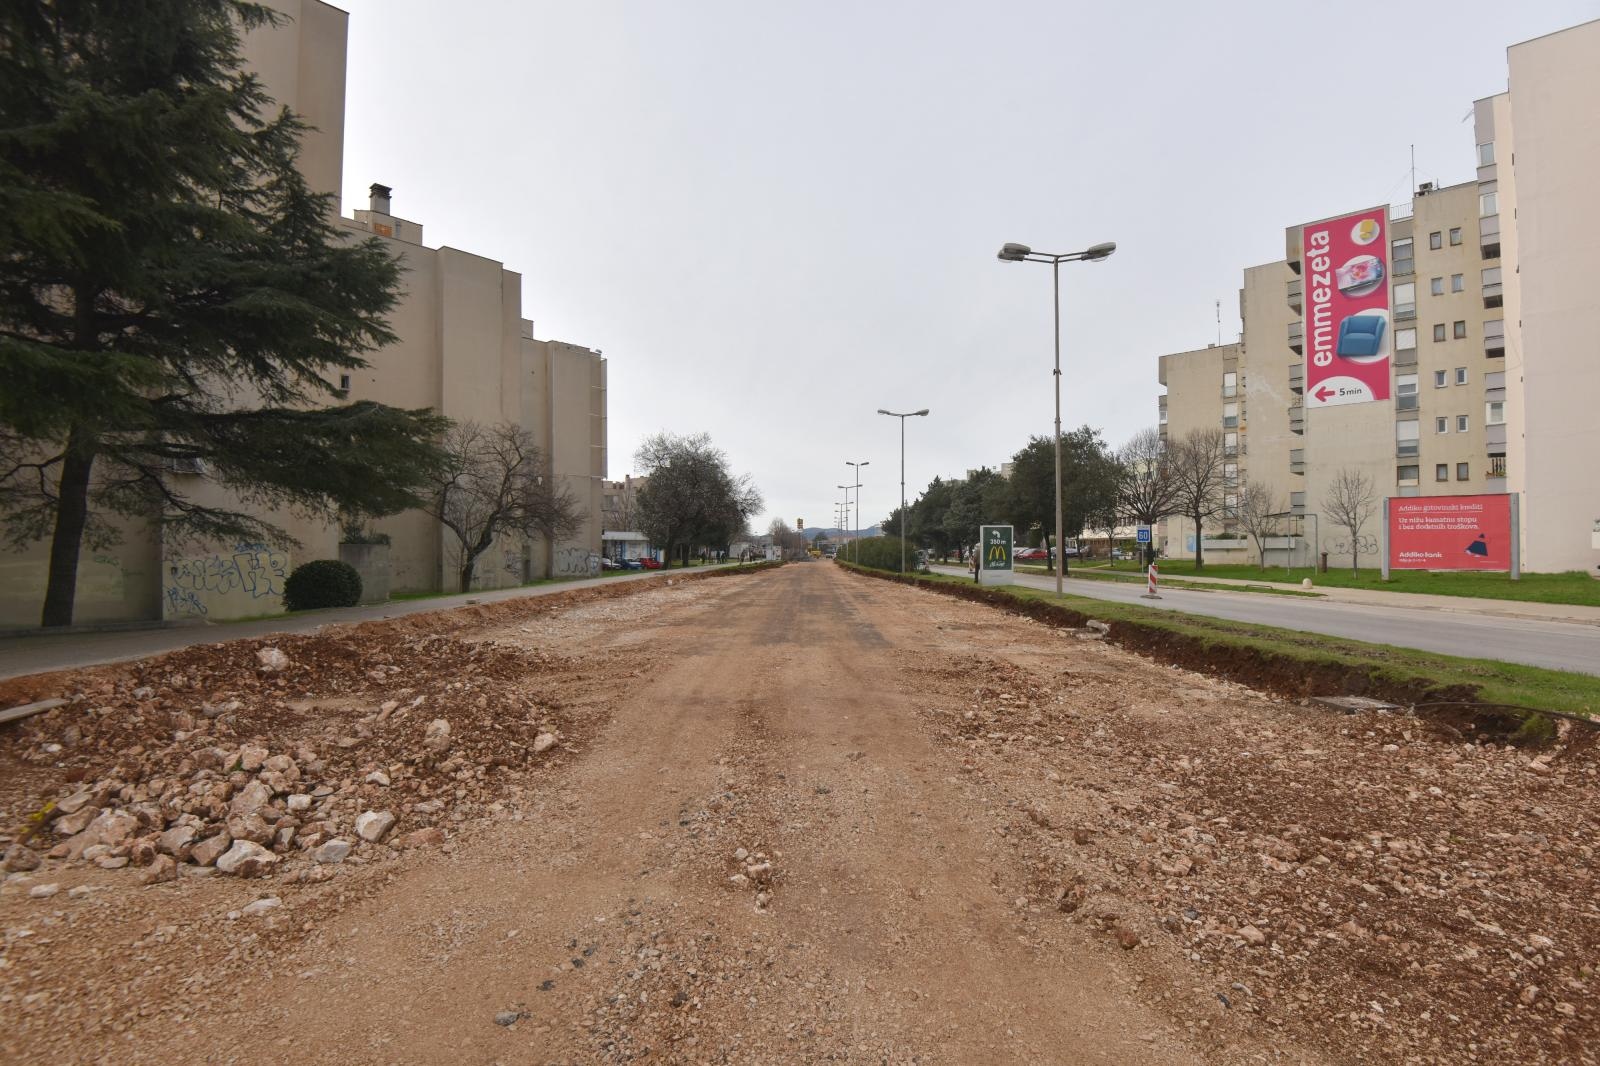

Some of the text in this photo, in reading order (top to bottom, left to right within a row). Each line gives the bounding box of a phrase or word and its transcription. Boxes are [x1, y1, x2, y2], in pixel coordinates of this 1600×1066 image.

[1306, 230, 1333, 367] emmezeta
[1339, 387, 1362, 397] 5 min
[1456, 516, 1477, 524] stopu
[1138, 531, 1148, 540] 60
